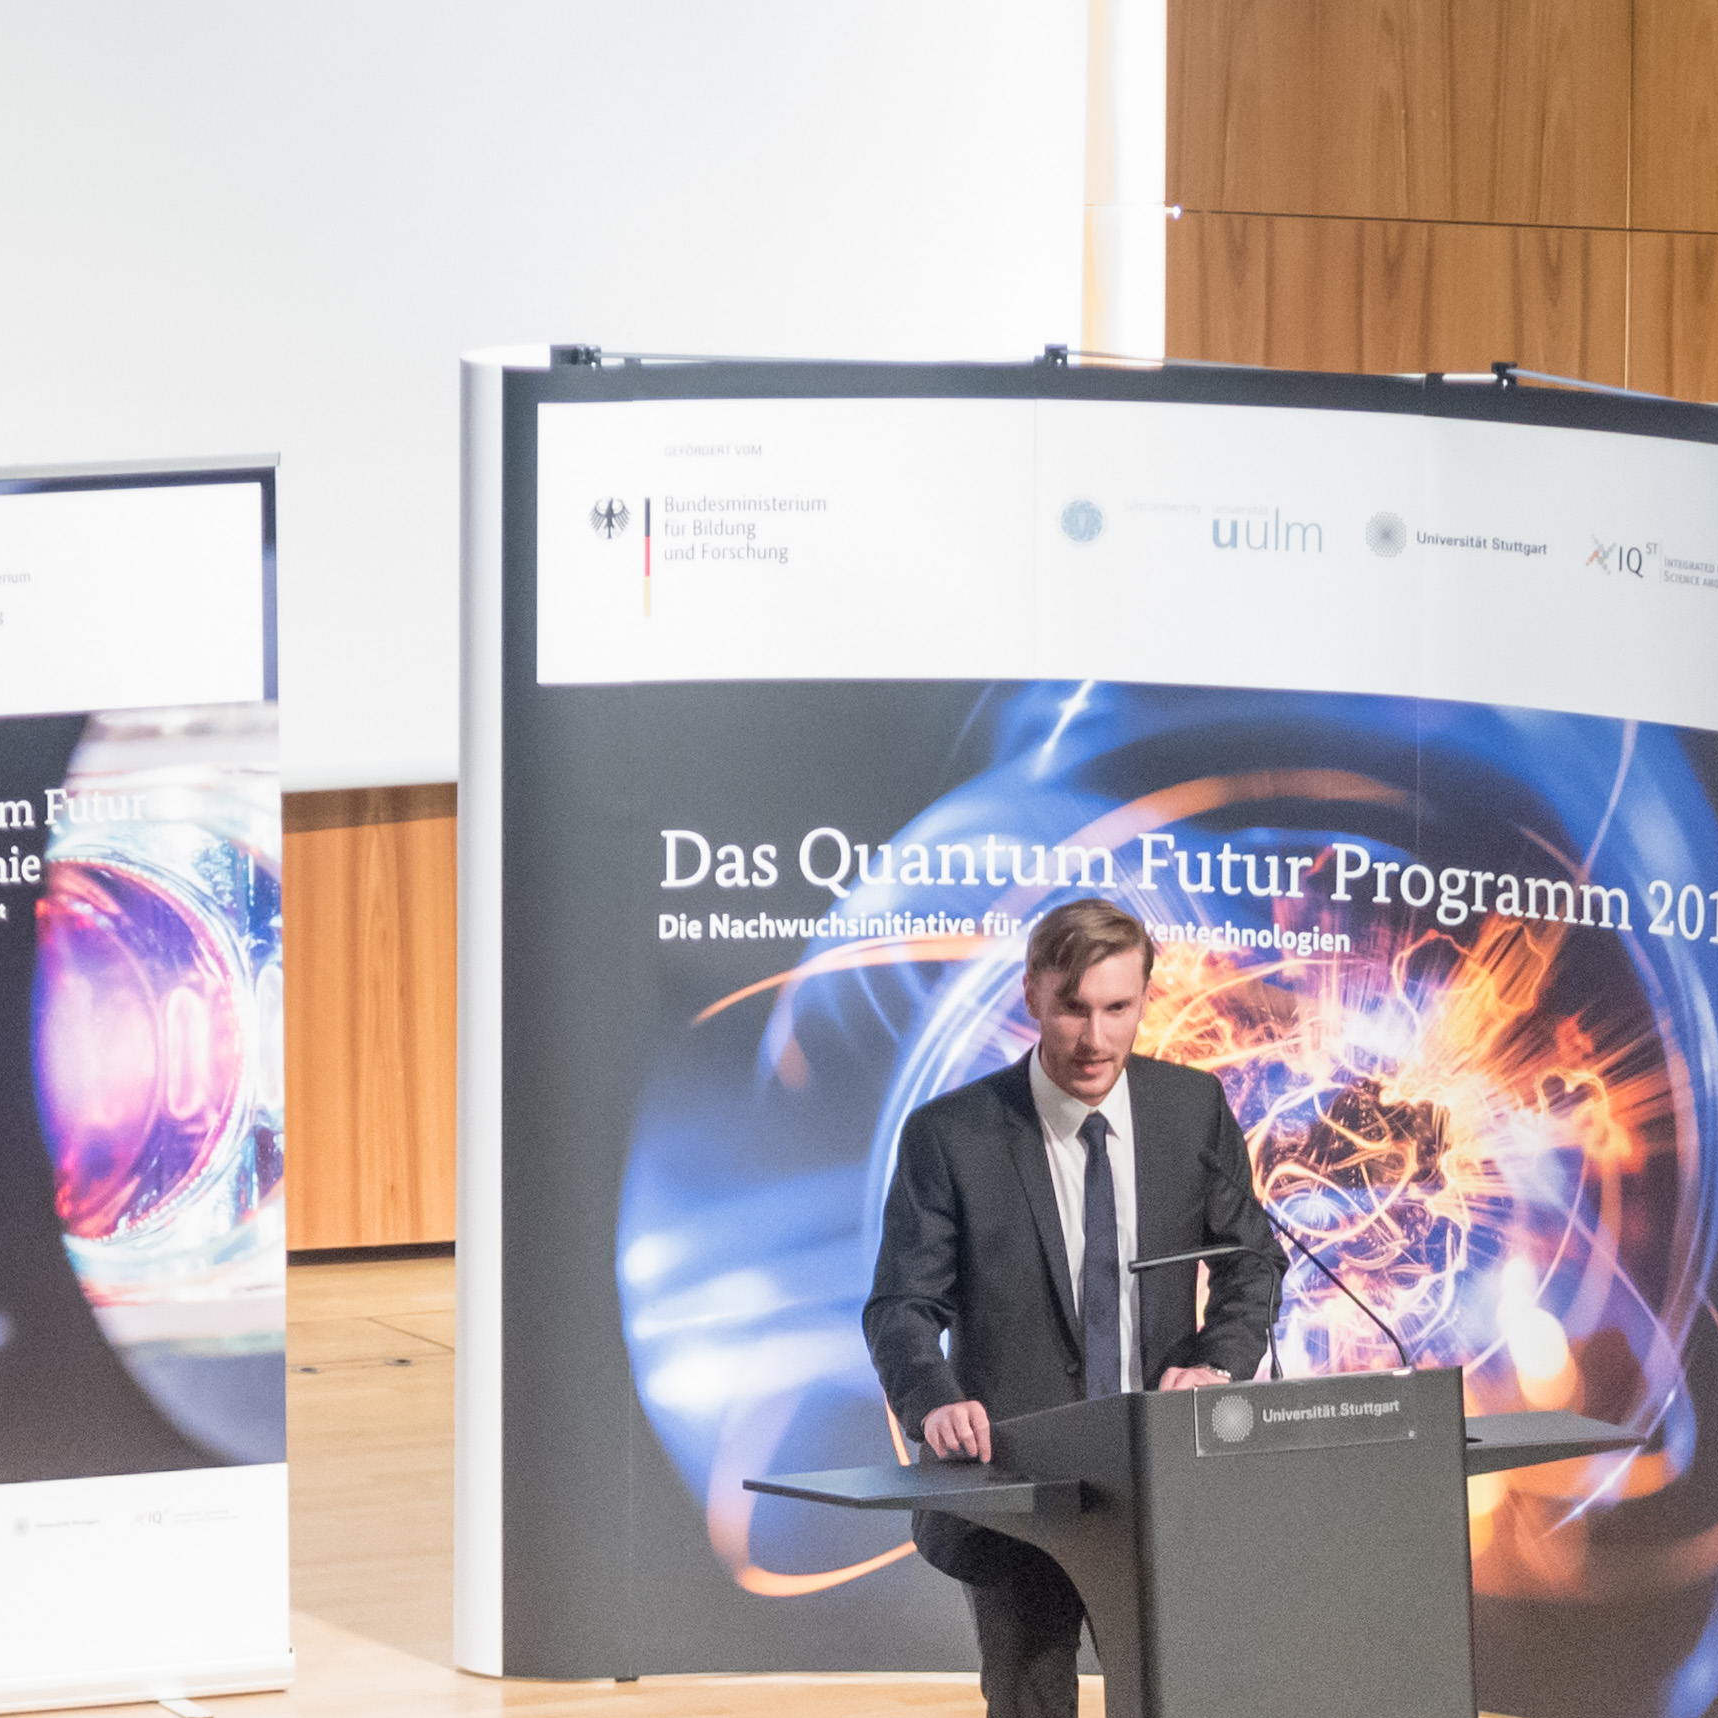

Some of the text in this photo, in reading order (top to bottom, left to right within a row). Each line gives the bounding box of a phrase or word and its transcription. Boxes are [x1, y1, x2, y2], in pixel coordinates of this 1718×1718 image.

[735, 444, 763, 456] VOM
[664, 496, 827, 513] Bundesministerium
[664, 520, 757, 540] für Bildung
[1212, 507, 1323, 553] uulm
[664, 543, 789, 563] und Forschung
[1416, 530, 1548, 556] Universität Stuttgart
[44, 788, 148, 827] Futur
[660, 828, 778, 889] Das
[799, 826, 1118, 898] Quantum
[1137, 832, 1313, 899] Futur
[1330, 842, 1634, 932] Programm
[658, 913, 701, 941] Die
[709, 911, 975, 940] Nachwuchsinitiative
[982, 911, 1022, 939] für
[1262, 1400, 1399, 1423] Universität Stuttgart
